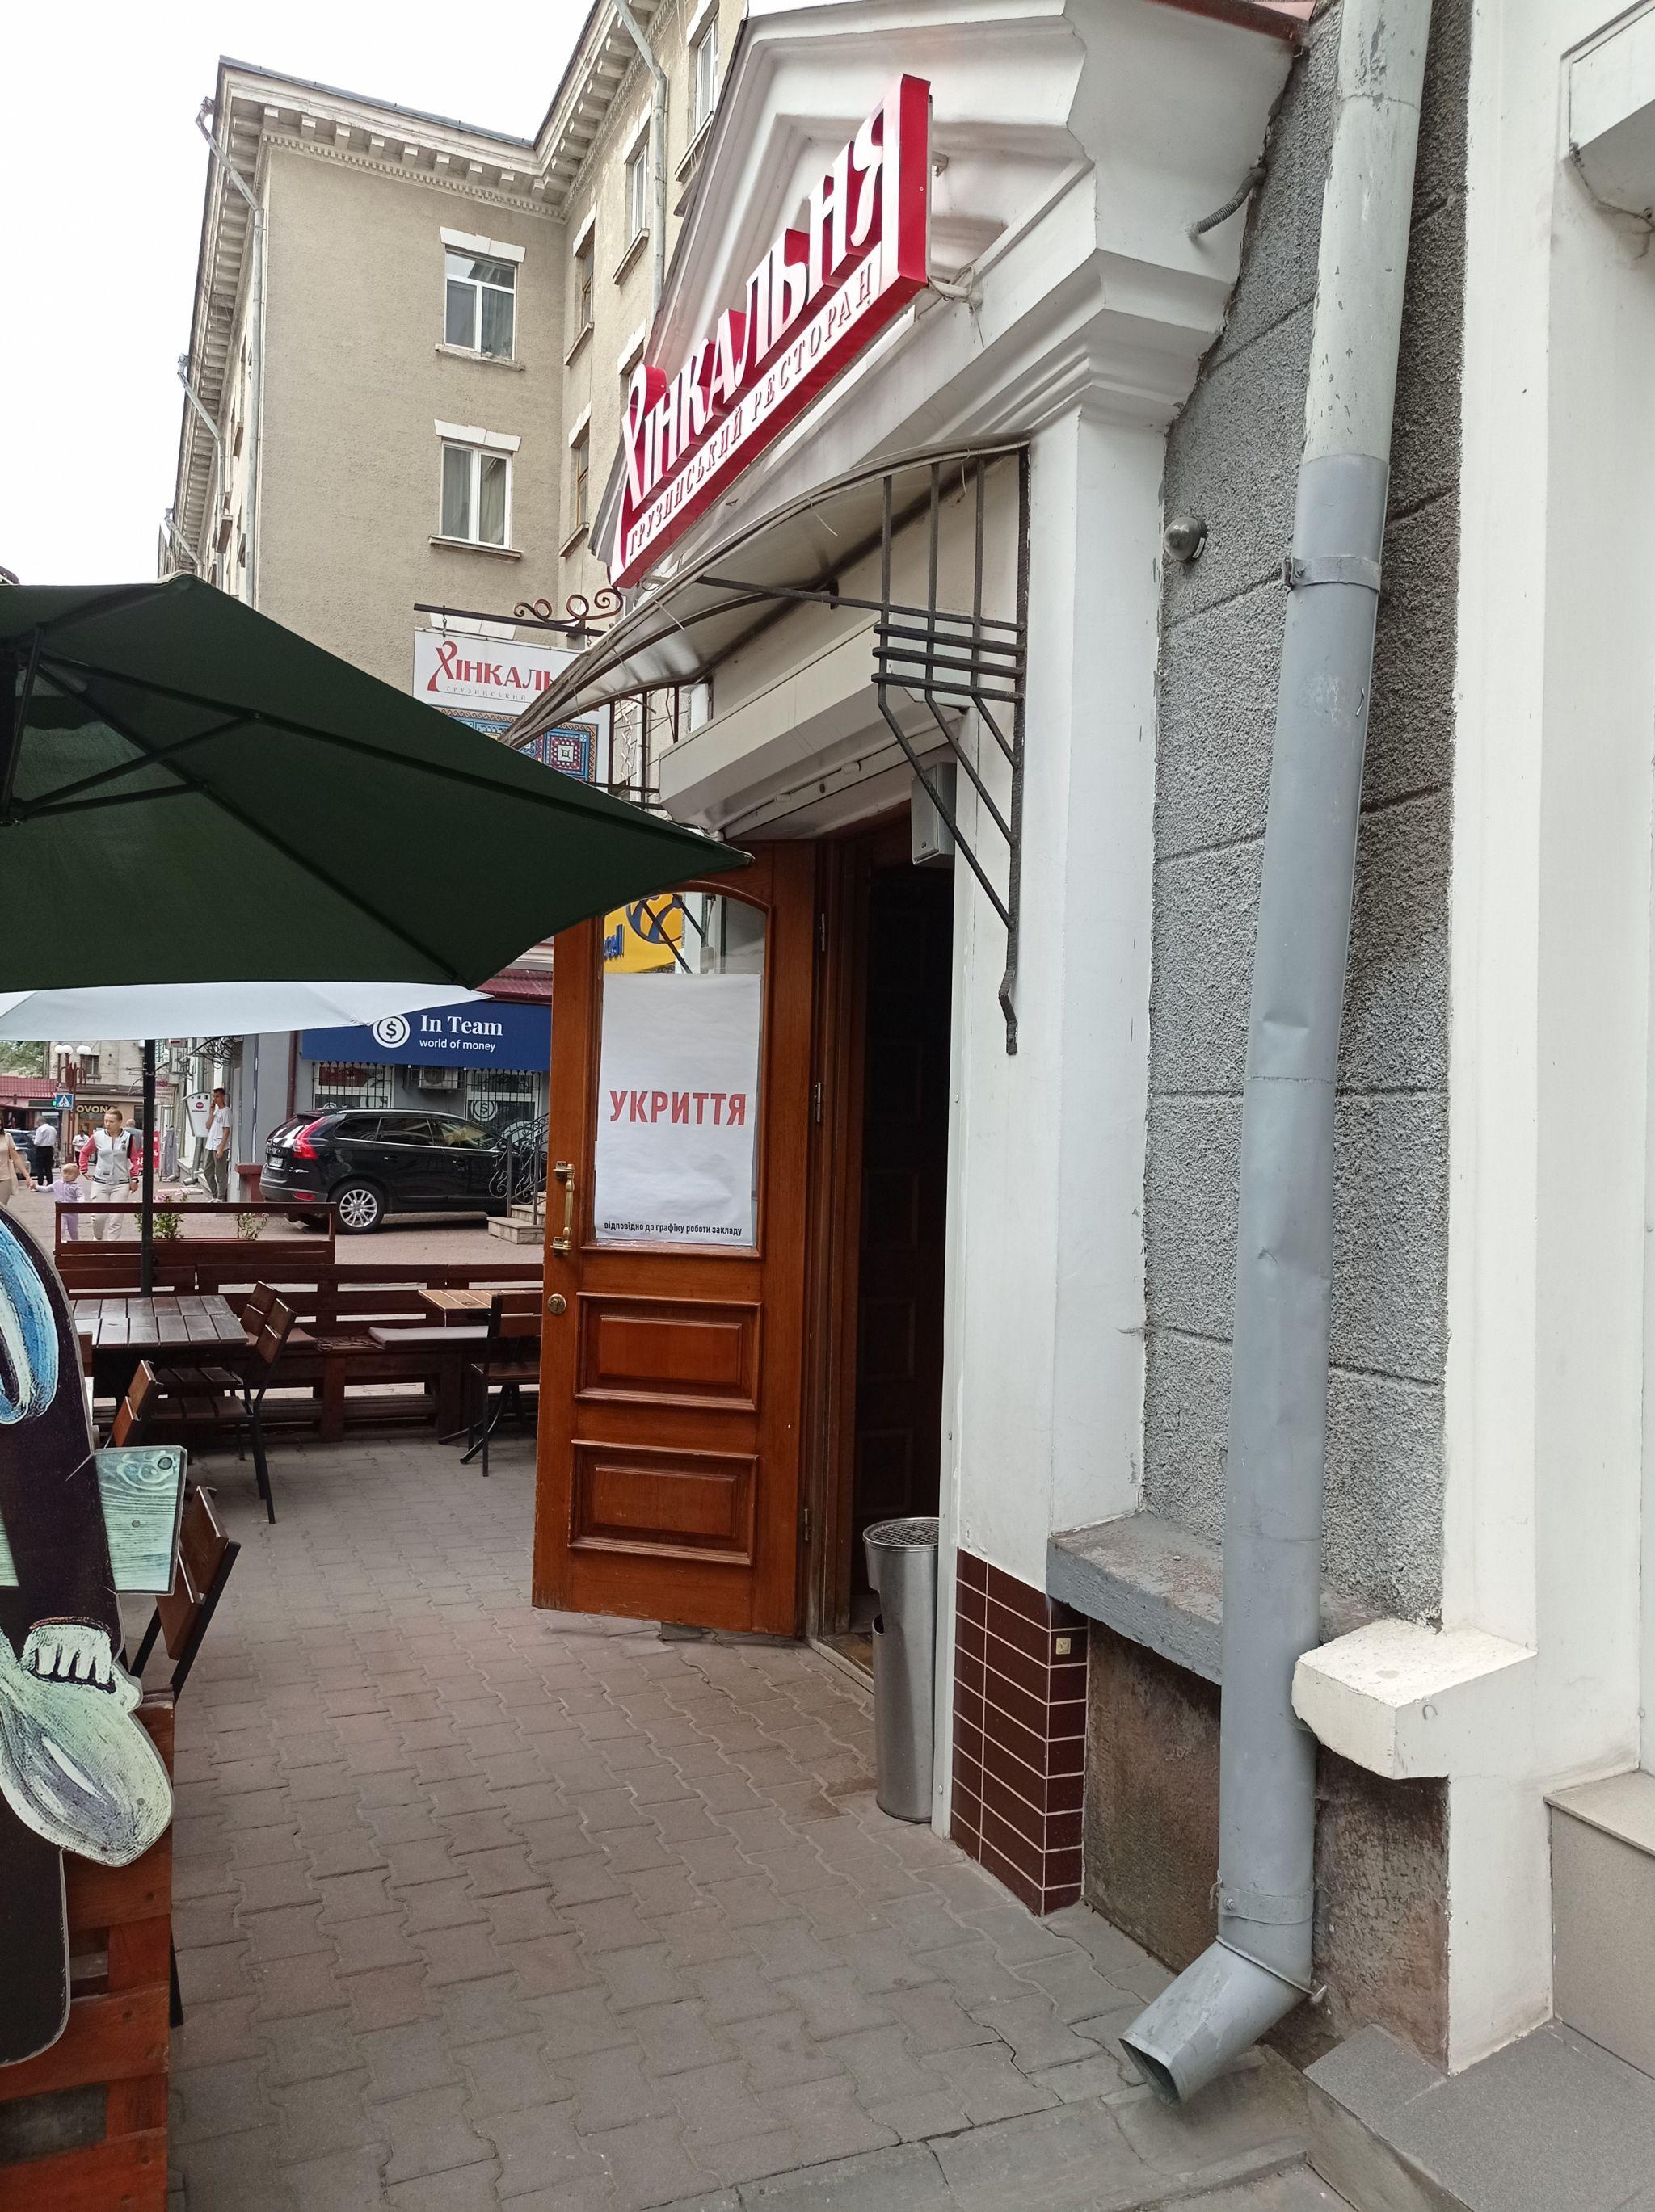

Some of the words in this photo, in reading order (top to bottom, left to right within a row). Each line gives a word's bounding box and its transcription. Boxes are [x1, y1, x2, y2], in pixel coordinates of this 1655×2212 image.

[610, 74, 903, 586] ХІНКАЛЬНЯ
[629, 406, 743, 557] ГРУЗИНСЬКИЙ
[752, 262, 873, 423] РЕСТОРАН
[446, 686, 526, 700] ГРУЗИНСЬКИЙ
[420, 1014, 442, 1032] In
[447, 1015, 503, 1037] Team
[419, 1038, 448, 1049] world
[449, 1039, 461, 1049] of
[462, 1041, 496, 1053] money
[609, 1089, 747, 1126] УКРИТТЯ
[604, 1221, 644, 1232] відповідно
[645, 1223, 655, 1233] до
[655, 1222, 684, 1234] графіку
[686, 1224, 710, 1234] роботи
[712, 1226, 742, 1237] закладу
